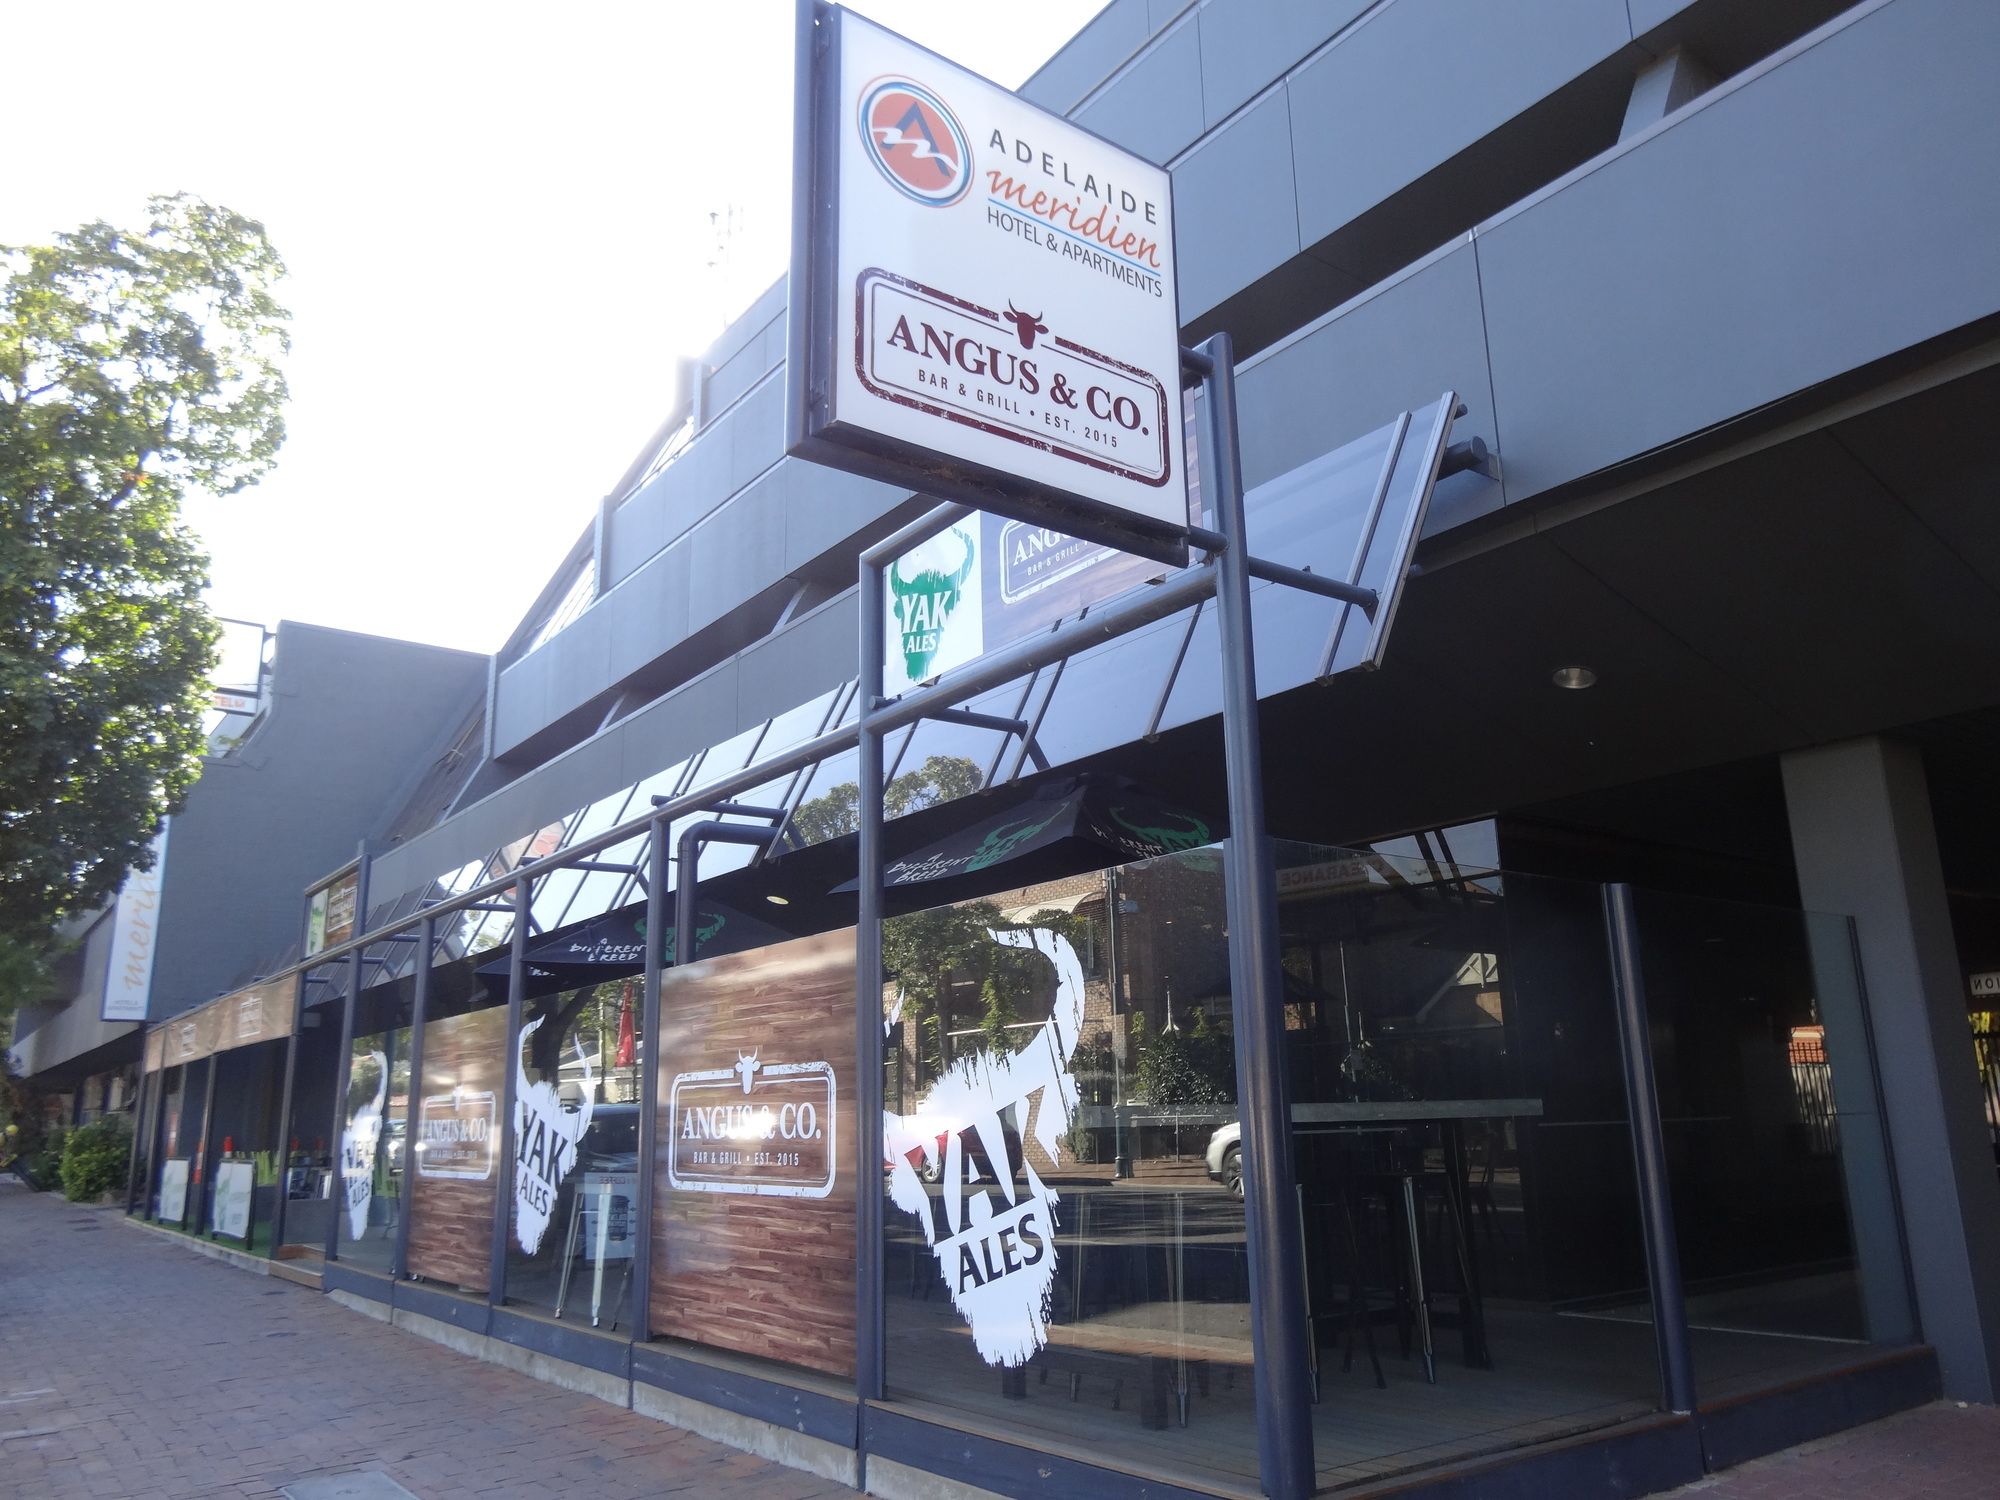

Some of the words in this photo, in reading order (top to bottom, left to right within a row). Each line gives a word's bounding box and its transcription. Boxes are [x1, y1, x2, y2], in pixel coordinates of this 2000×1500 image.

[989, 128, 1157, 226] ADELAIDE
[986, 170, 1161, 268] meridien
[987, 206, 1042, 246] HOTEL
[1046, 233, 1058, 253] &
[1062, 240, 1163, 298] APARTMENTS
[886, 314, 1040, 396] ANGUS
[1050, 372, 1079, 410] &
[1086, 386, 1150, 436] CO.
[918, 368, 948, 391] BAR
[958, 383, 967, 396] &
[976, 388, 1020, 415] GRILL
[1044, 411, 1076, 434] EST.
[1084, 426, 1118, 448] 2015
[901, 590, 952, 635] YAK
[905, 632, 937, 653] ALES
[518, 1102, 568, 1188] YAK
[681, 1105, 754, 1140] ANGUS
[779, 1102, 822, 1140] CO.
[693, 1151, 708, 1164] BAR
[711, 1151, 717, 1164] &
[719, 1151, 742, 1165] GRILL
[754, 1152, 774, 1165] EST.
[776, 1152, 799, 1166] 2015
[520, 1171, 549, 1217] ALES
[904, 1085, 1046, 1246] YAK
[958, 1212, 1044, 1295] ALES
